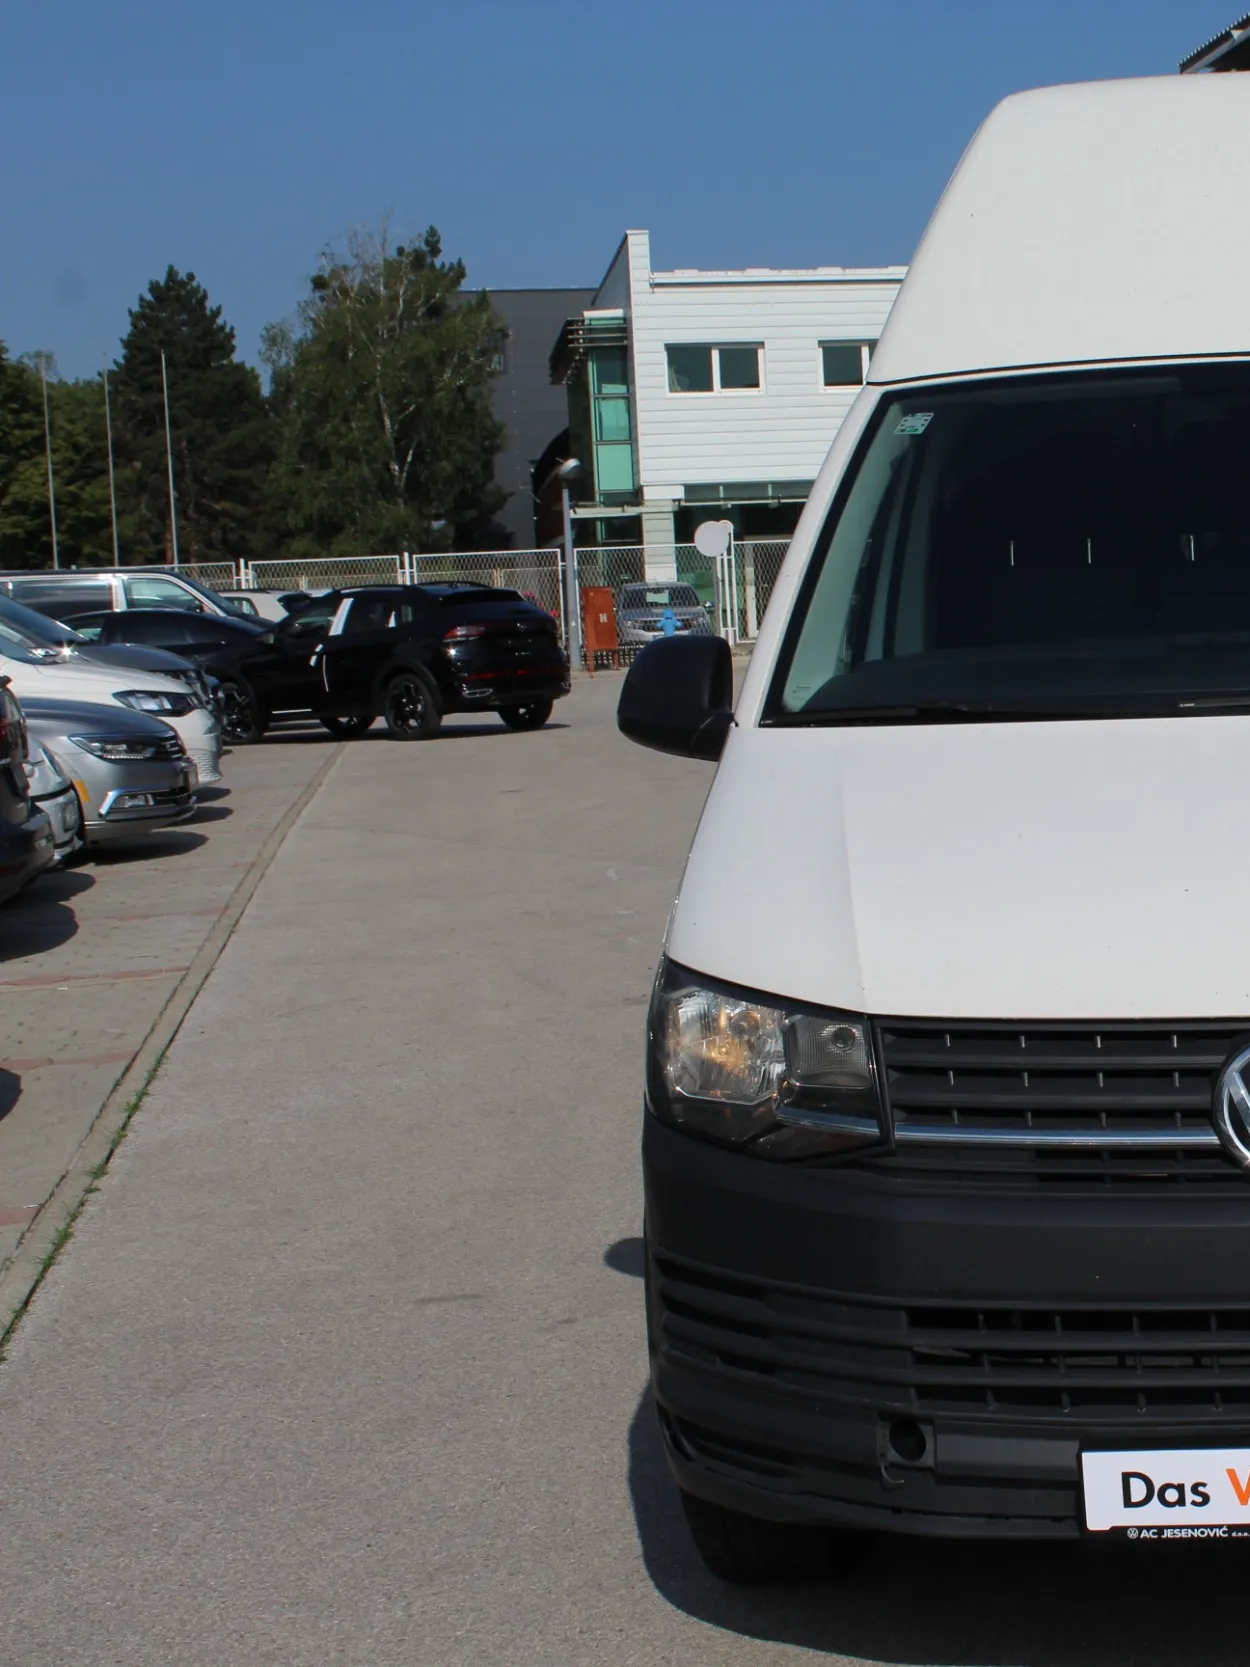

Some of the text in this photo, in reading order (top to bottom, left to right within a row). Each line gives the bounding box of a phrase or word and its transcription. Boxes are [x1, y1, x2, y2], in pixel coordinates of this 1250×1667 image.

[1121, 1471, 1211, 1509] Das
[1140, 1529, 1158, 1539] AC
[1161, 1525, 1229, 1539] JESENOVIĆ
